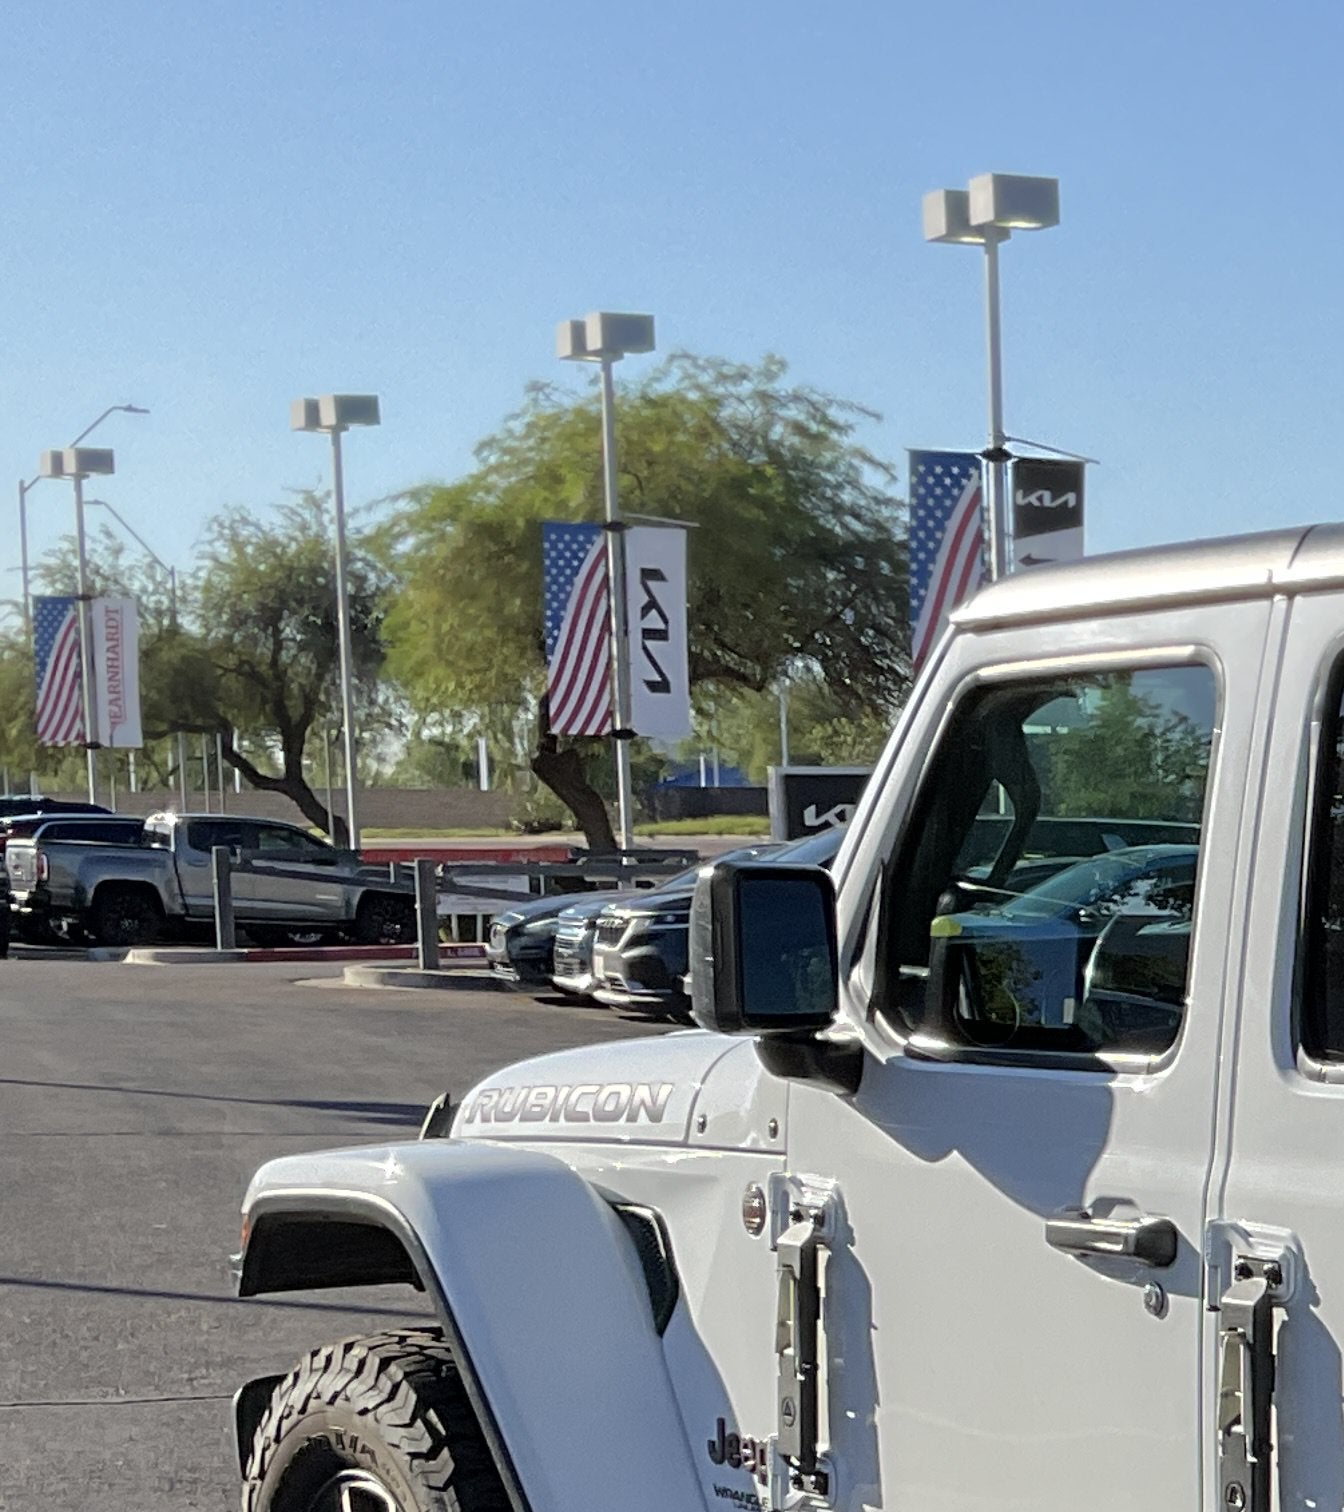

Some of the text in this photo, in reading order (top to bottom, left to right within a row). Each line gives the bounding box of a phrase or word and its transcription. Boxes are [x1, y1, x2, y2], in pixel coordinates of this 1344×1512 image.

[104, 605, 122, 726] EARNHARDT
[465, 1083, 673, 1123] RUBICON
[707, 1417, 768, 1486] Jeep
[713, 1483, 769, 1510] WRANGLE
